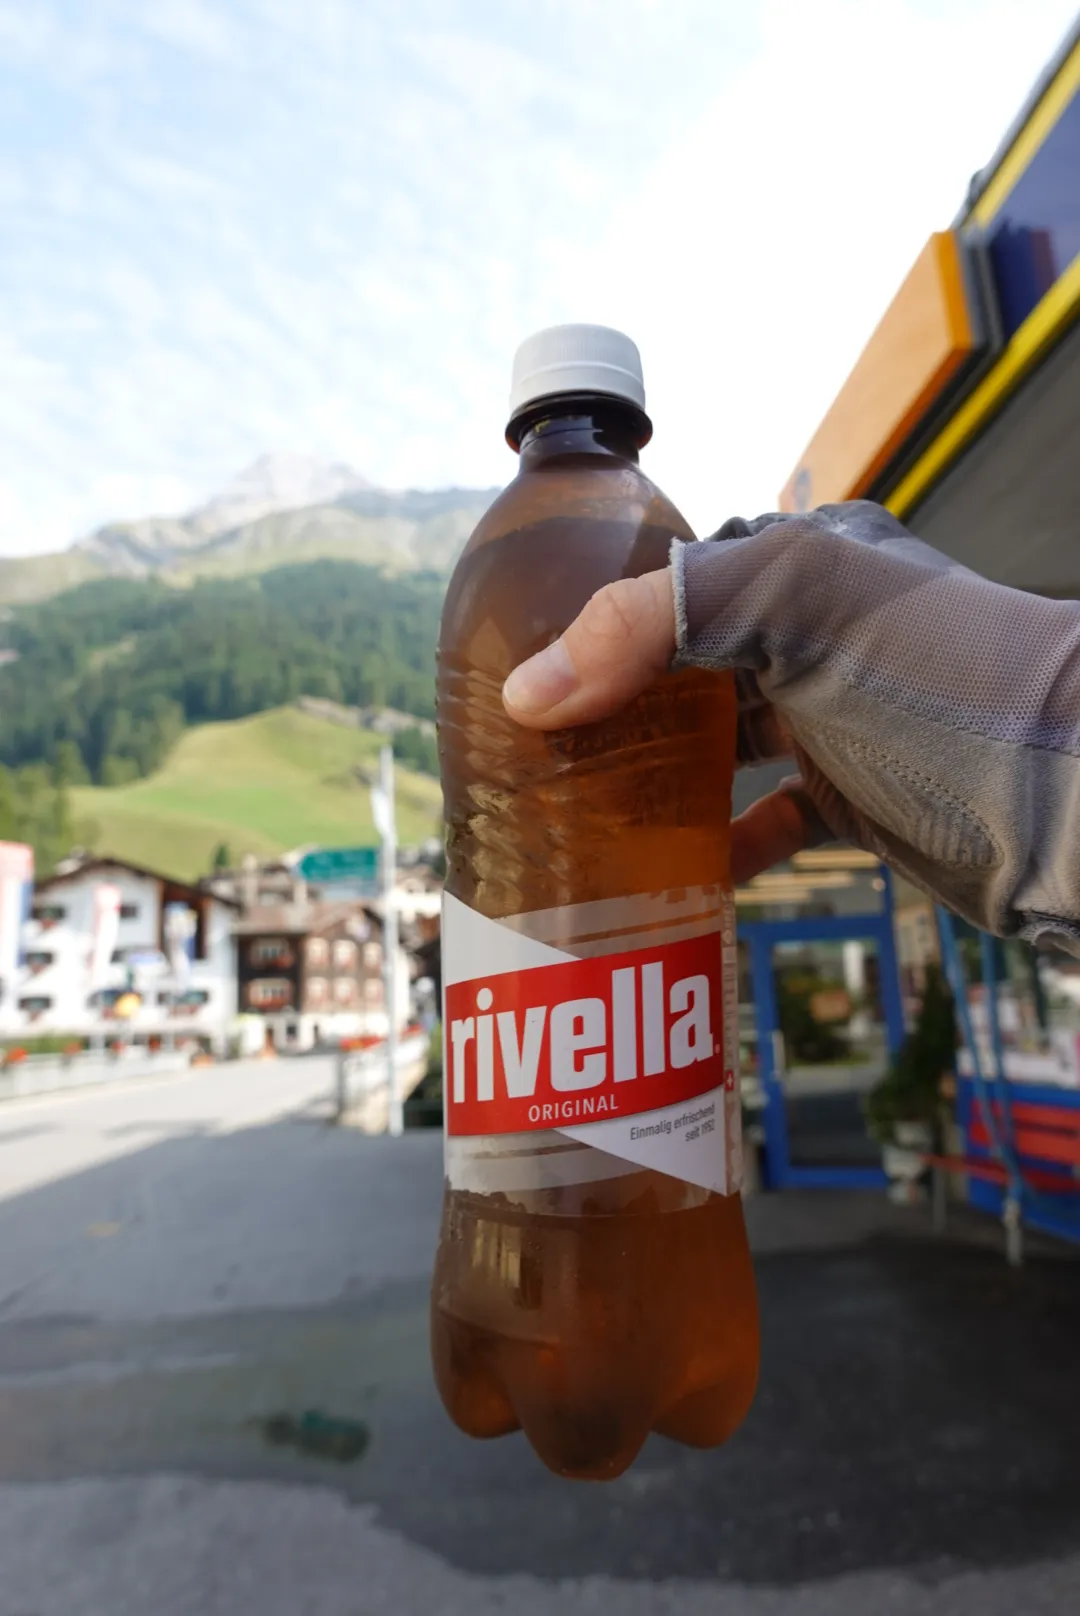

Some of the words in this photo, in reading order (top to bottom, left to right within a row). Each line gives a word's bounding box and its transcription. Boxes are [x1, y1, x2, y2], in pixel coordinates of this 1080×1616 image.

[451, 960, 714, 1104] rivella
[528, 1093, 619, 1123] ORIGINAL
[630, 1120, 672, 1141] Einmalig
[674, 1102, 715, 1130] erfrischend
[685, 1126, 700, 1142] seit
